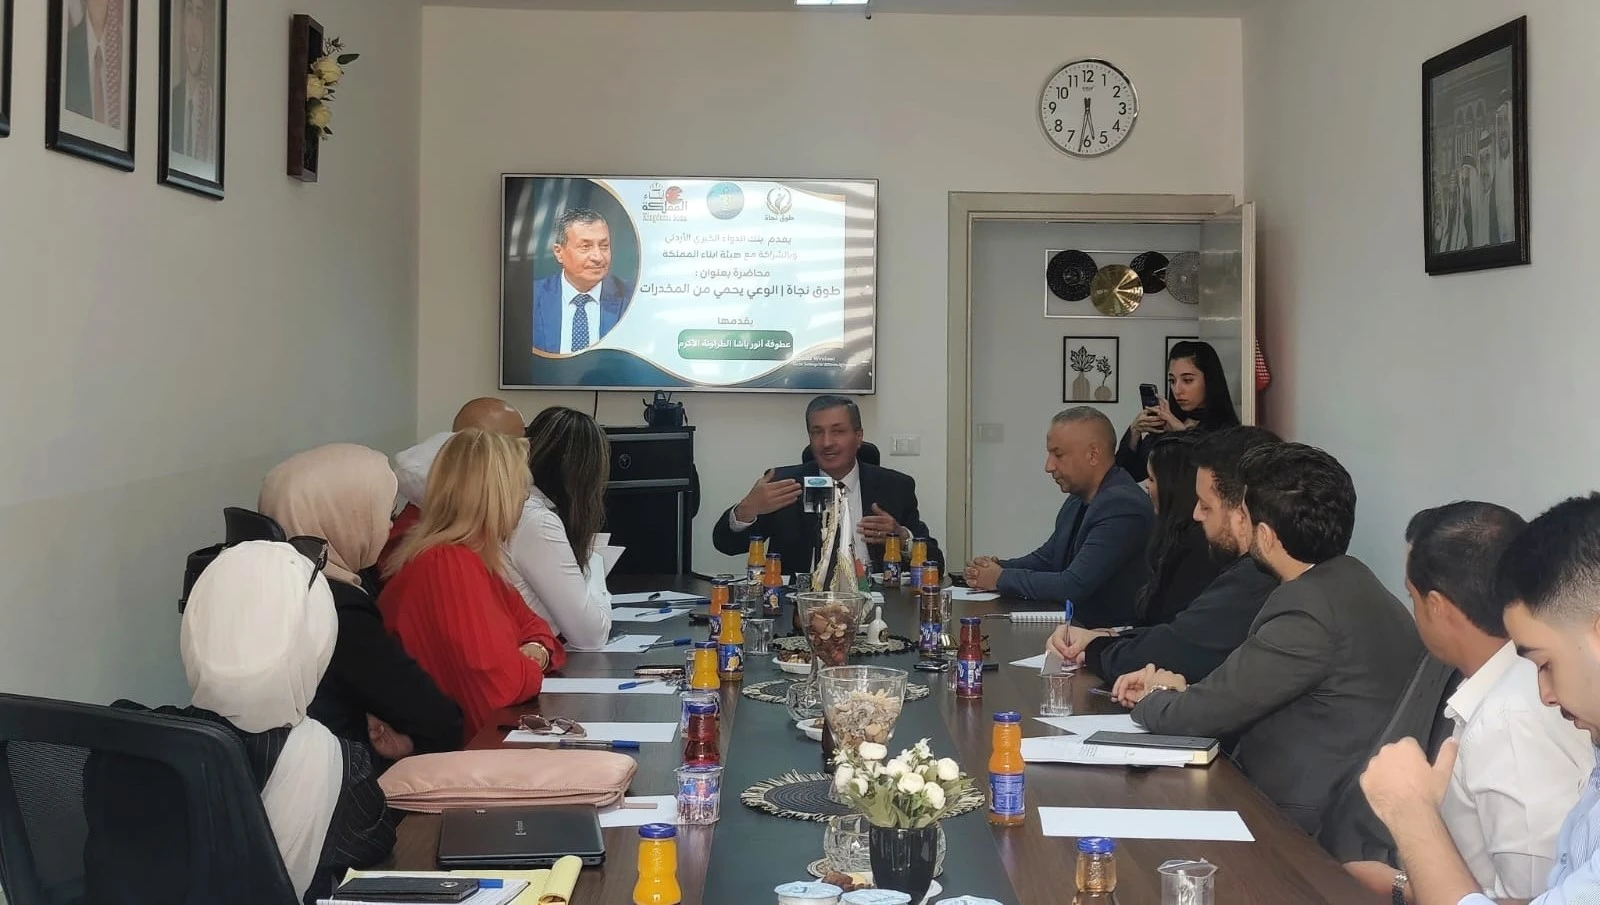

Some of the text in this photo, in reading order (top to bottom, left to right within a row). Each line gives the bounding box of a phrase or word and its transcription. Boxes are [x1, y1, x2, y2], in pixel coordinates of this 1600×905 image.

[1068, 75, 1078, 88] 11
[1082, 70, 1094, 83] 12
[1102, 74, 1106, 87] 1
[1056, 87, 1069, 100] 10
[1112, 85, 1121, 98] 2
[1048, 101, 1057, 114] 9
[1118, 102, 1127, 115] 3
[1054, 119, 1063, 132] 8
[1112, 119, 1120, 132] 4
[1067, 130, 1075, 143] 7
[1083, 135, 1092, 148] 6
[1099, 131, 1108, 144] 5
[662, 249, 699, 259] المملكة
[720, 249, 742, 259] هيئة
[700, 268, 731, 280] بعنوان
[733, 267, 771, 279] محاضرة
[639, 283, 690, 296] المخدرات
[693, 285, 711, 296] من
[713, 285, 744, 299] يحمي
[746, 284, 779, 298] الوعي
[786, 285, 810, 295] نجاة
[812, 285, 841, 298] طوق
[717, 316, 754, 326] يقدمها
